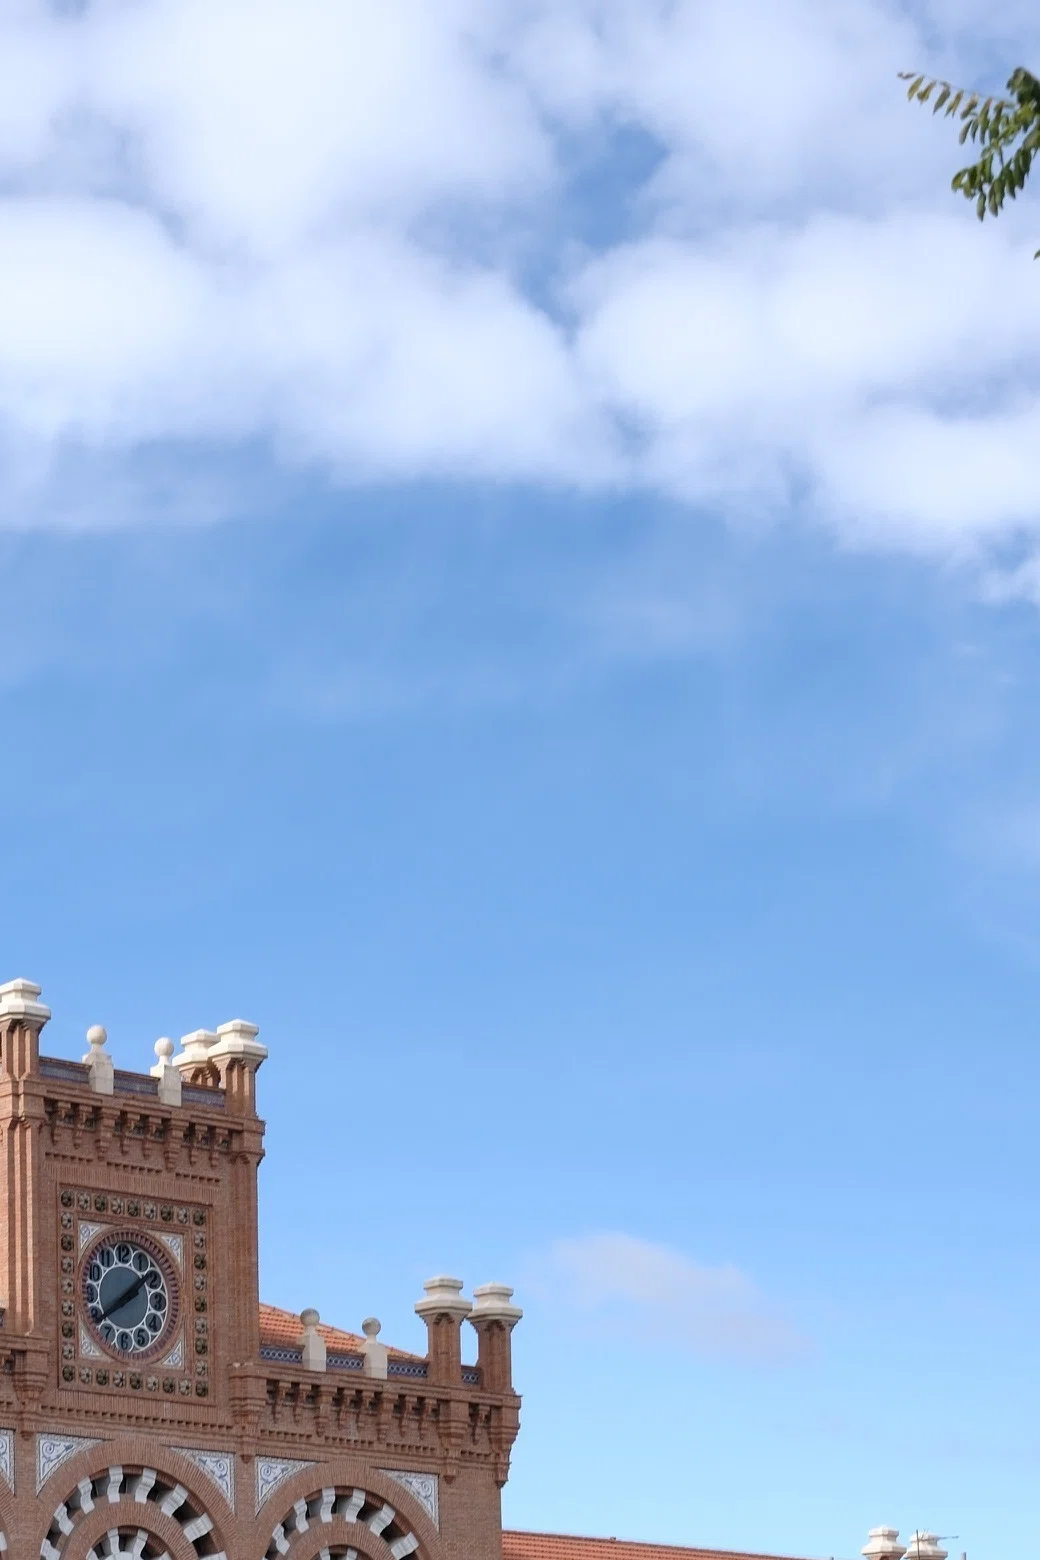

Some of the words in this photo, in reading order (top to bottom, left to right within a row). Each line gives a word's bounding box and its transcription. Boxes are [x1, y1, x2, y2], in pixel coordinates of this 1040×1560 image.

[100, 1249, 111, 1266] 11
[118, 1245, 129, 1264] 12
[137, 1254, 143, 1271] 1
[89, 1265, 100, 1281] 10
[148, 1272, 158, 1290] 2
[87, 1284, 94, 1303] 9
[154, 1294, 163, 1311] 3
[149, 1315, 158, 1332] 4
[104, 1326, 112, 1341] 7
[137, 1329, 146, 1347] 5
[120, 1335, 128, 1350] 6
